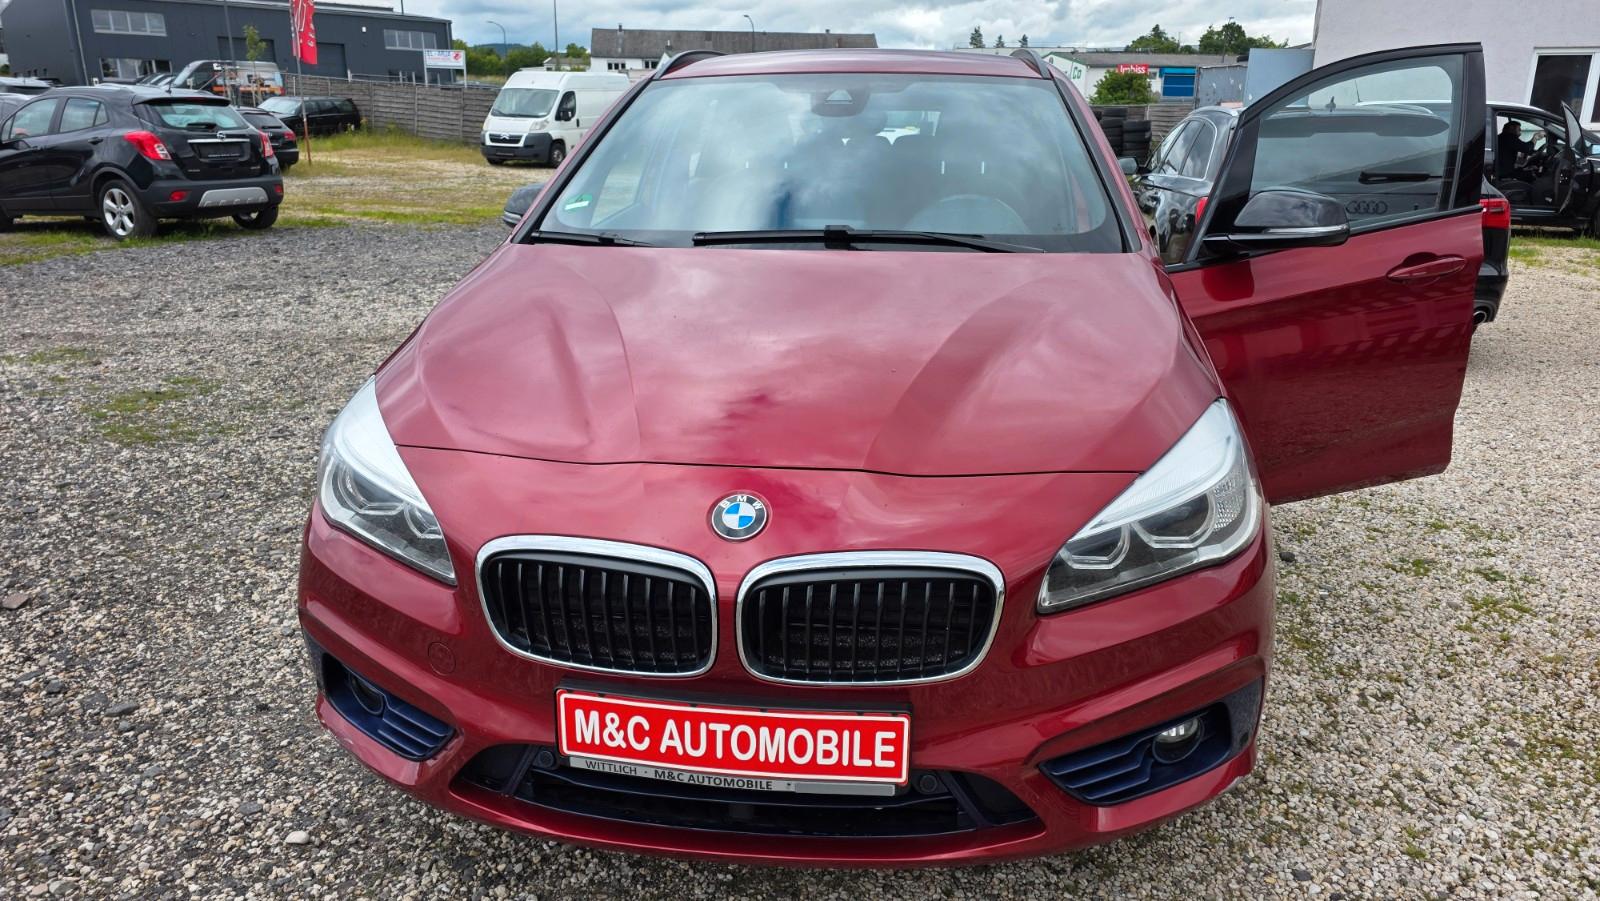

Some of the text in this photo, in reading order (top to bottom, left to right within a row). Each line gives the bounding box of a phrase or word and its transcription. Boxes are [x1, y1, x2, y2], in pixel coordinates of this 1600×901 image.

[719, 494, 765, 510] BMW
[574, 708, 897, 769] M&C AUTOMOBILE
[585, 759, 774, 790] WITTLICH M&C AUTOMOBILE
